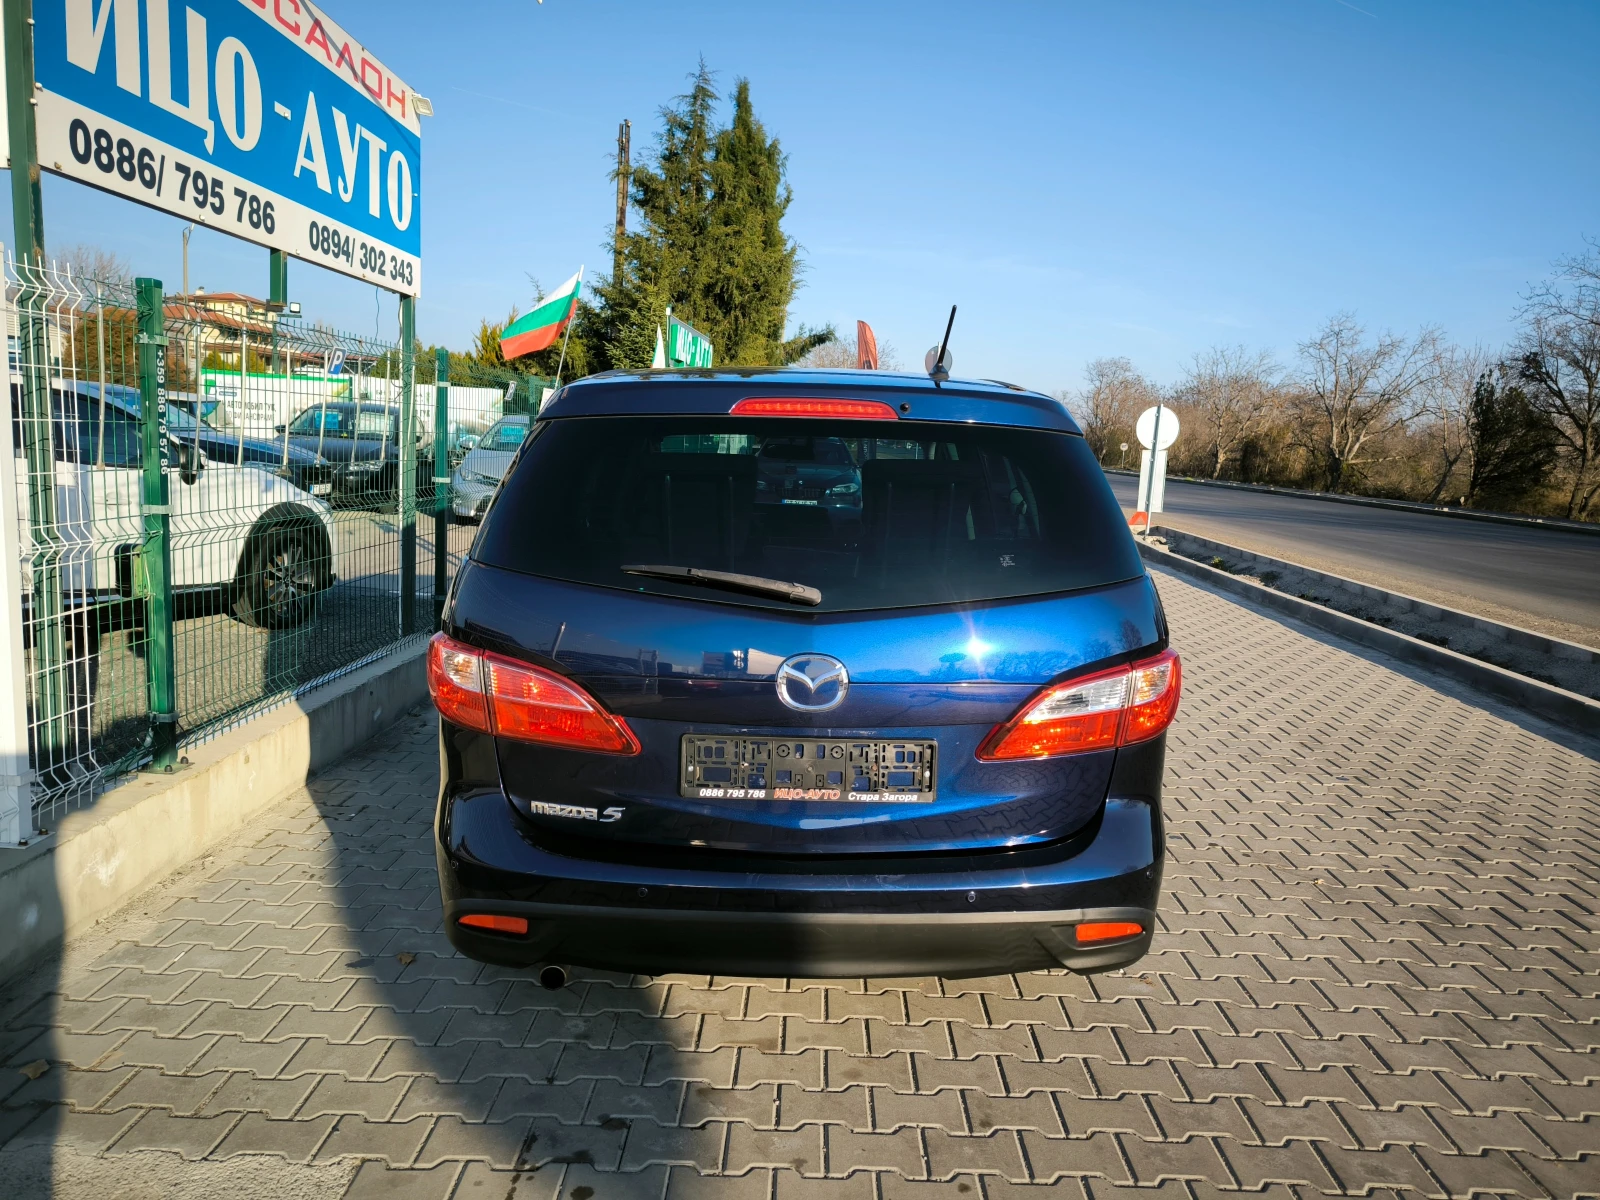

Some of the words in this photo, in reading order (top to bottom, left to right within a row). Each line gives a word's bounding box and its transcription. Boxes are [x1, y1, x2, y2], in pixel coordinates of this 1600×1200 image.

[69, 118, 165, 197] 0886/
[174, 164, 225, 216] 795
[233, 186, 276, 235] 786
[309, 220, 356, 268] 0894/
[359, 242, 387, 277] 302
[390, 256, 414, 287] 343
[157, 349, 165, 384] +359
[331, 350, 343, 372] P
[157, 388, 166, 413] 886
[159, 417, 167, 433] 79
[160, 438, 169, 456] 57
[160, 458, 168, 475] 86
[699, 788, 724, 798] 0886
[726, 788, 745, 799] 795
[747, 789, 766, 799] 786
[773, 788, 841, 801] ИЦО-АУТО
[848, 791, 880, 802] Стара
[881, 792, 918, 802] Загора
[599, 806, 626, 823] 5
